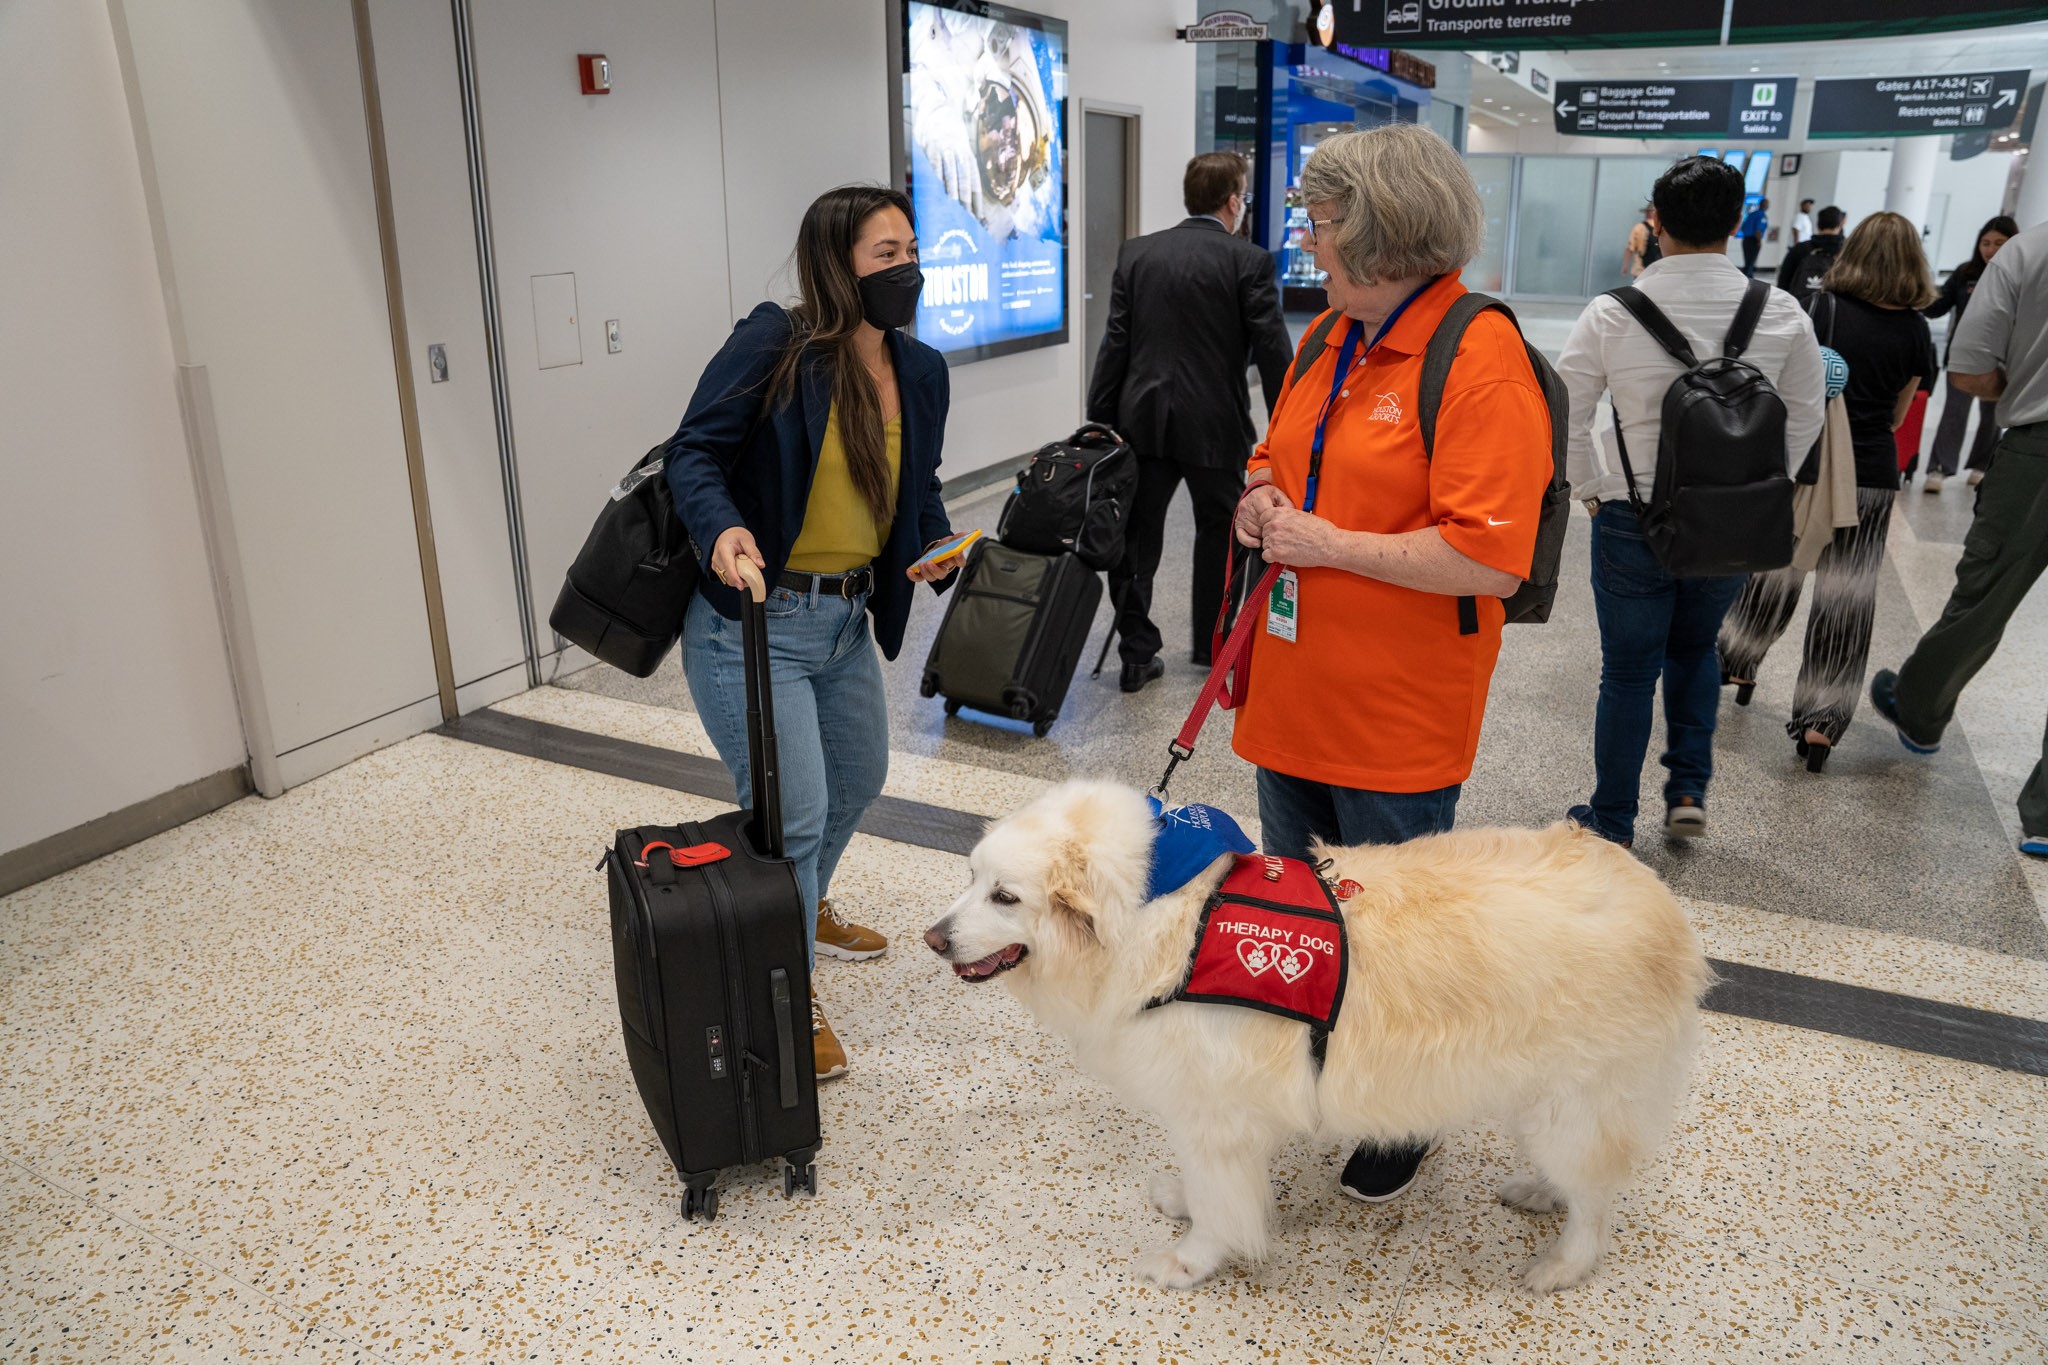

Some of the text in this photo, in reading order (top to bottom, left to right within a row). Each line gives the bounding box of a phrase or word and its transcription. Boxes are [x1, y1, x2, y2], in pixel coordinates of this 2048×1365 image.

[1427, 14, 1572, 33] Transporte terrestre
[1190, 27, 1263, 39] CHOCOLATE FACTORY
[1876, 77, 1968, 92] Gates A17-A24
[1600, 86, 1676, 98] Baggage Claim
[1598, 110, 1710, 122] Ground Transportation
[1740, 110, 1783, 122] EXIT to
[1898, 106, 1962, 117] Restrooms
[922, 263, 989, 308] HOUSTON
[1216, 921, 1335, 956] THERAPY DOG
